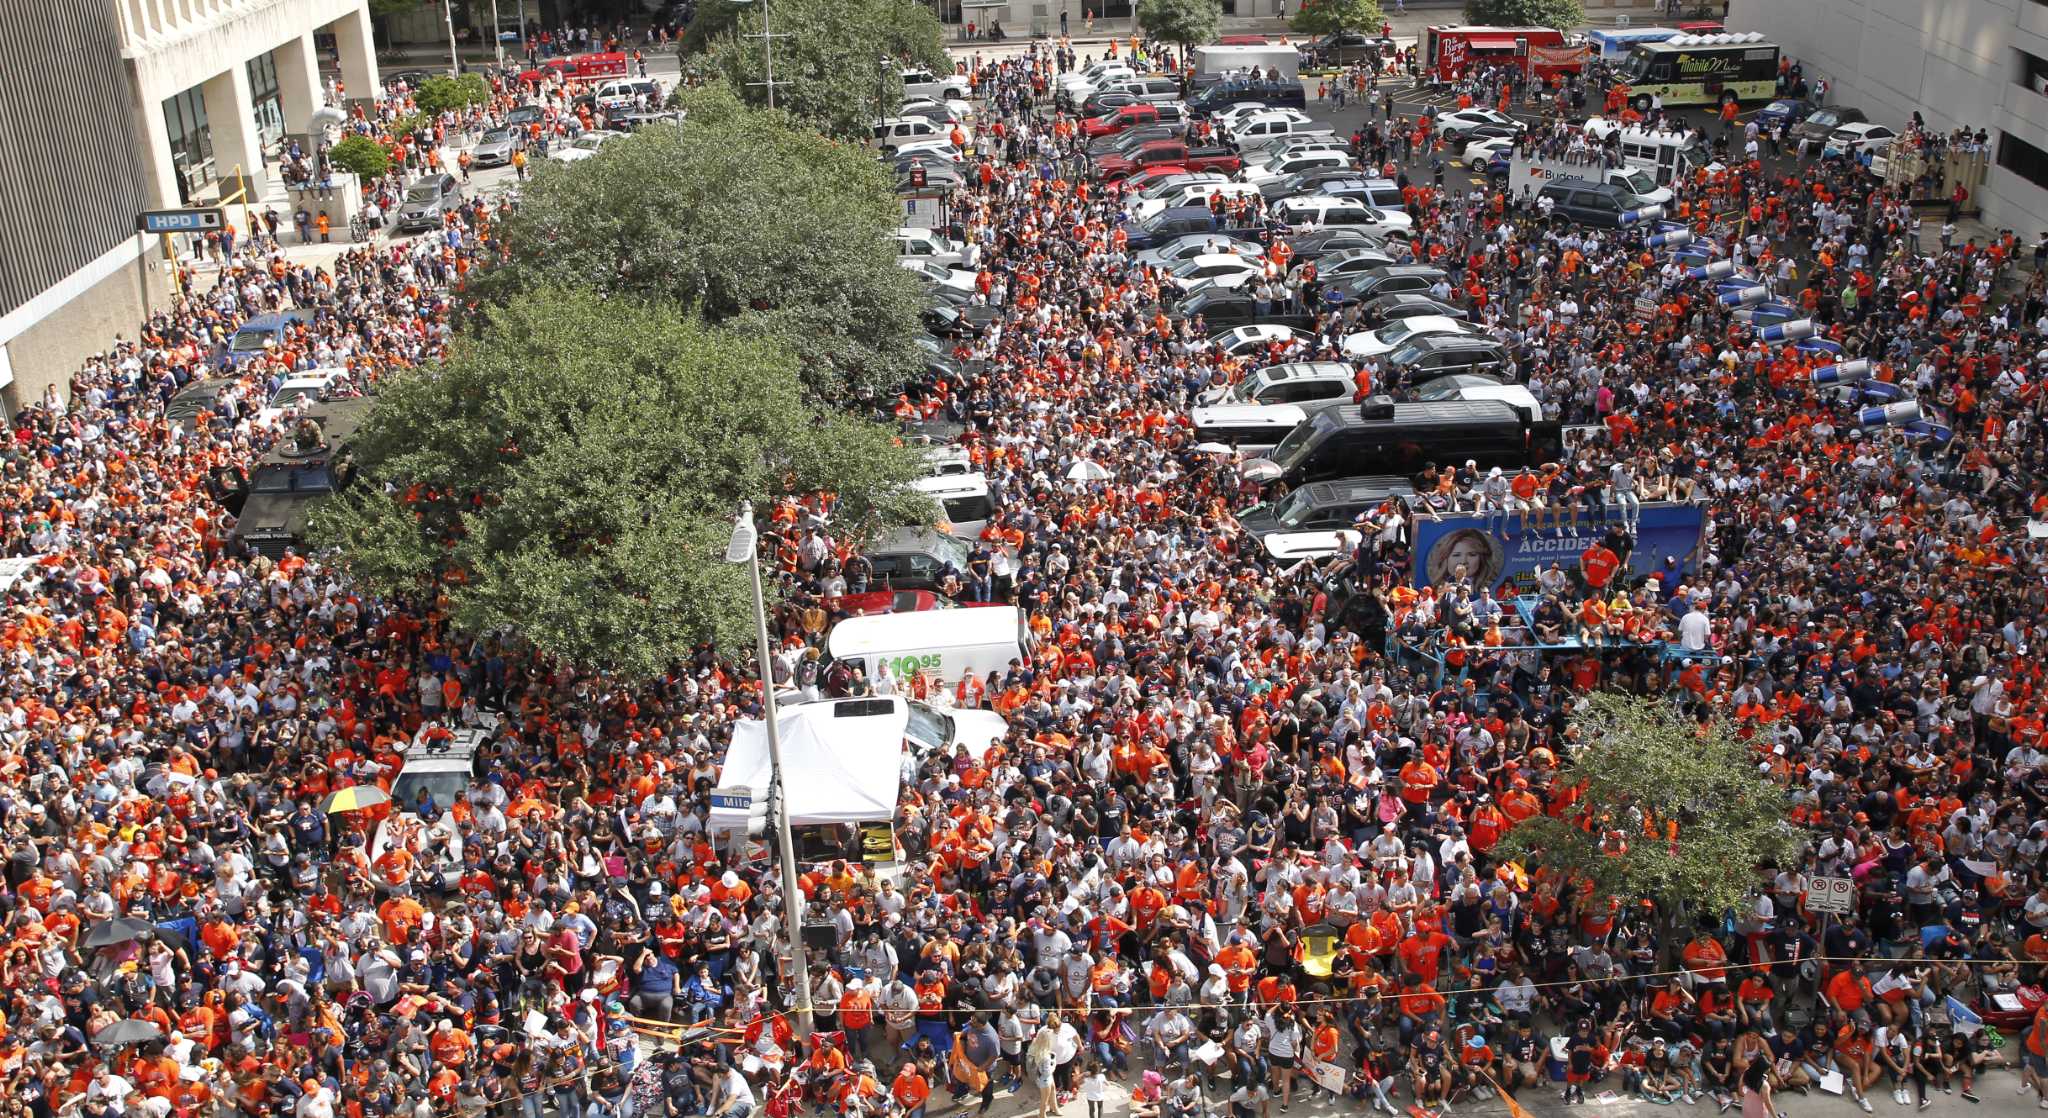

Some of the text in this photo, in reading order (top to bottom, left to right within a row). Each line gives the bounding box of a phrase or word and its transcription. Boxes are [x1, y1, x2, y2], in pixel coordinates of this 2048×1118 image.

[1443, 38, 1466, 56] Burger
[1546, 169, 1584, 180] Budget
[155, 215, 192, 227] HPD
